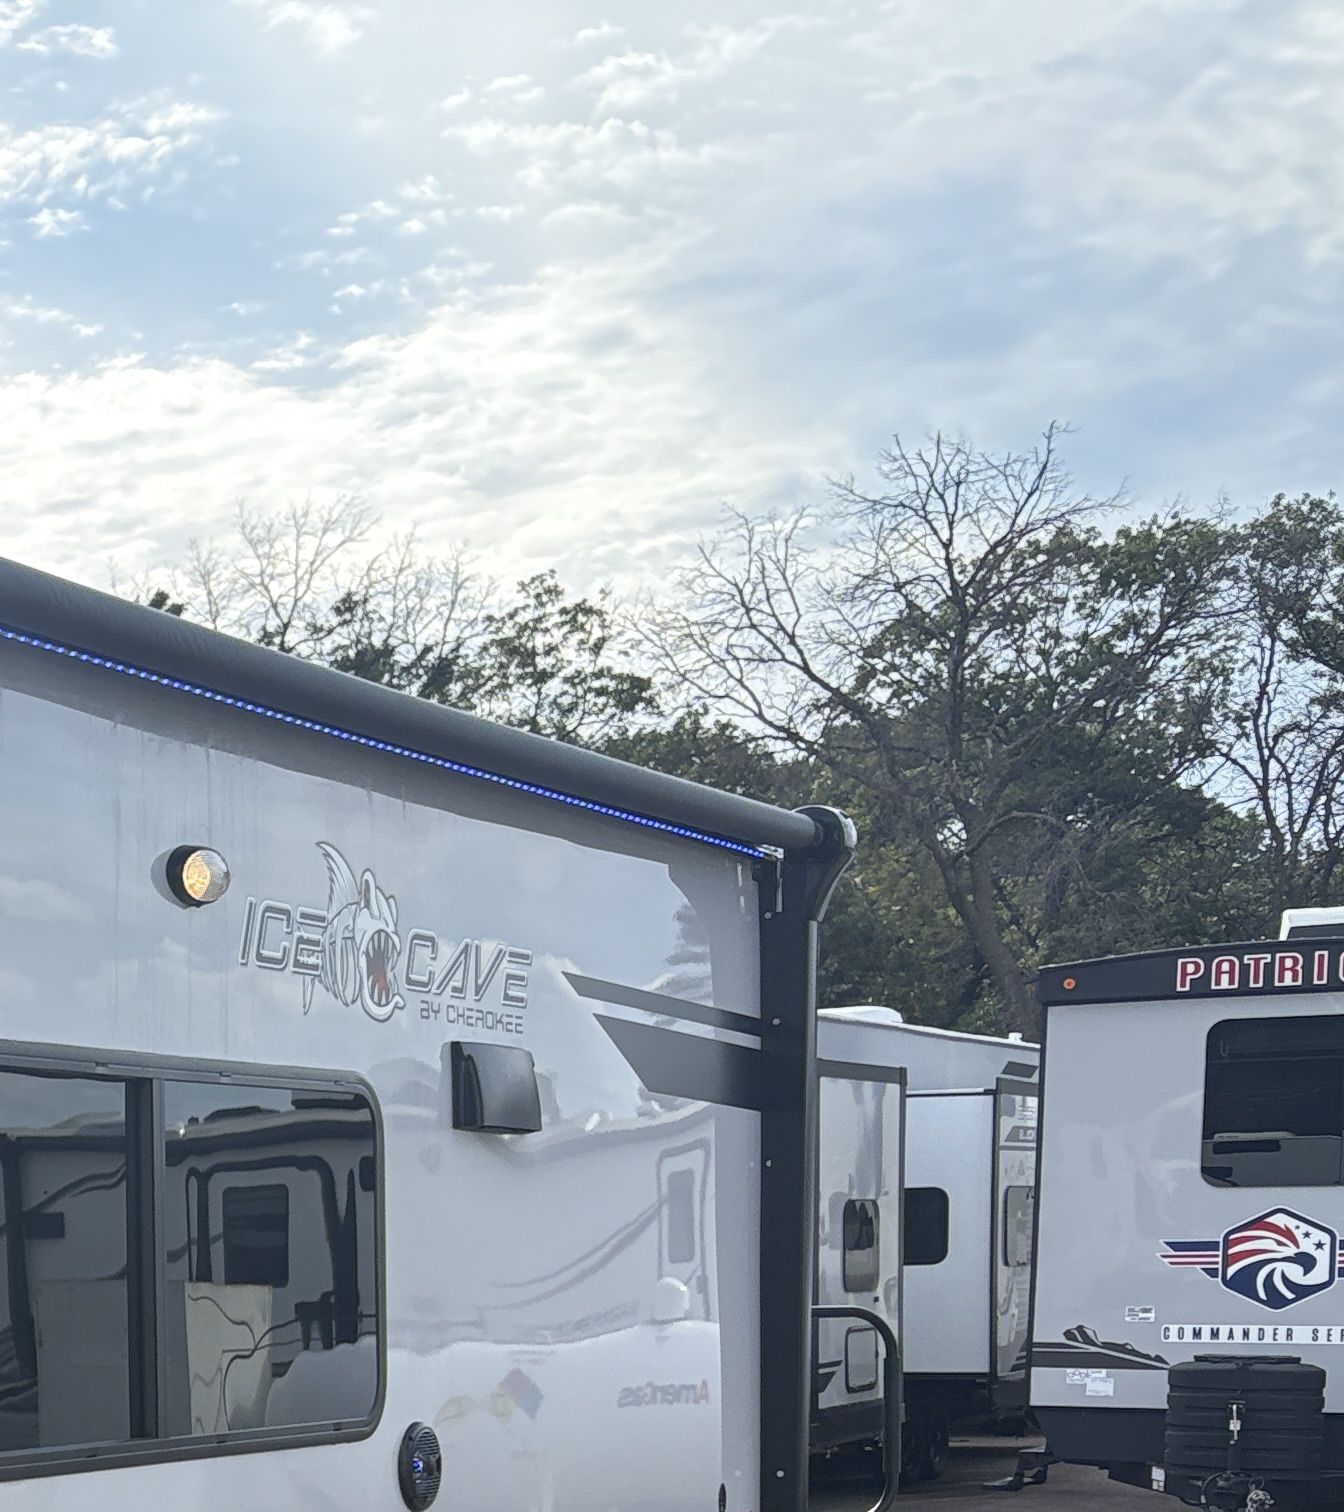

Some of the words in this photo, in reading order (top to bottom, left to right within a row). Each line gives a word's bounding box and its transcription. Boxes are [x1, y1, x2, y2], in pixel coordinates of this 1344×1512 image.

[239, 897, 329, 976] ICE
[404, 929, 532, 1007] CAVE
[1176, 950, 1344, 992] PATRI
[419, 1000, 441, 1021] BY
[446, 1004, 525, 1034] CHEROKEE
[1163, 1326, 1293, 1342] COMMANDER
